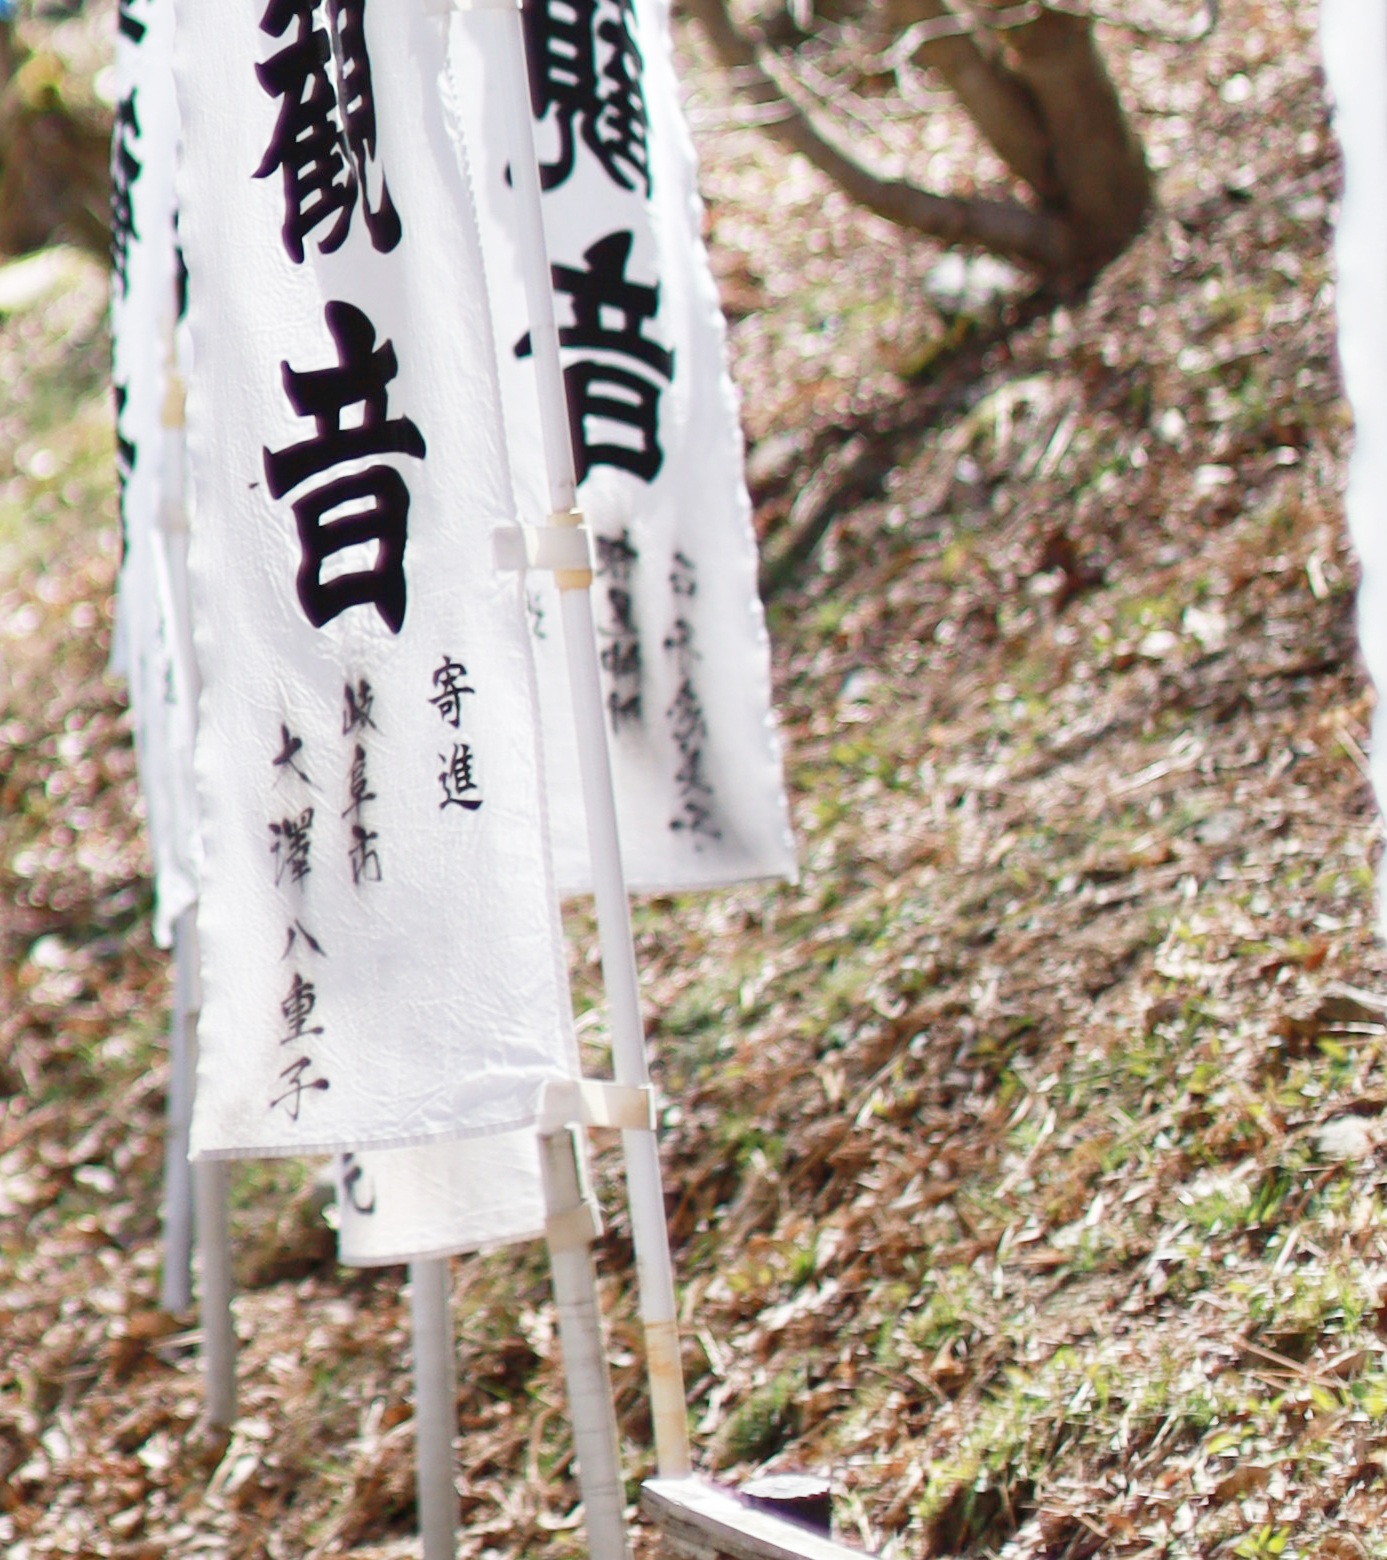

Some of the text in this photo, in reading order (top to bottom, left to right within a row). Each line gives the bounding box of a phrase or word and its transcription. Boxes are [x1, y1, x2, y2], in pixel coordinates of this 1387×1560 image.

[339, 677, 383, 886] 岐阜市
[429, 654, 484, 812] 寄進
[269, 722, 331, 1120] 大澤八重子
